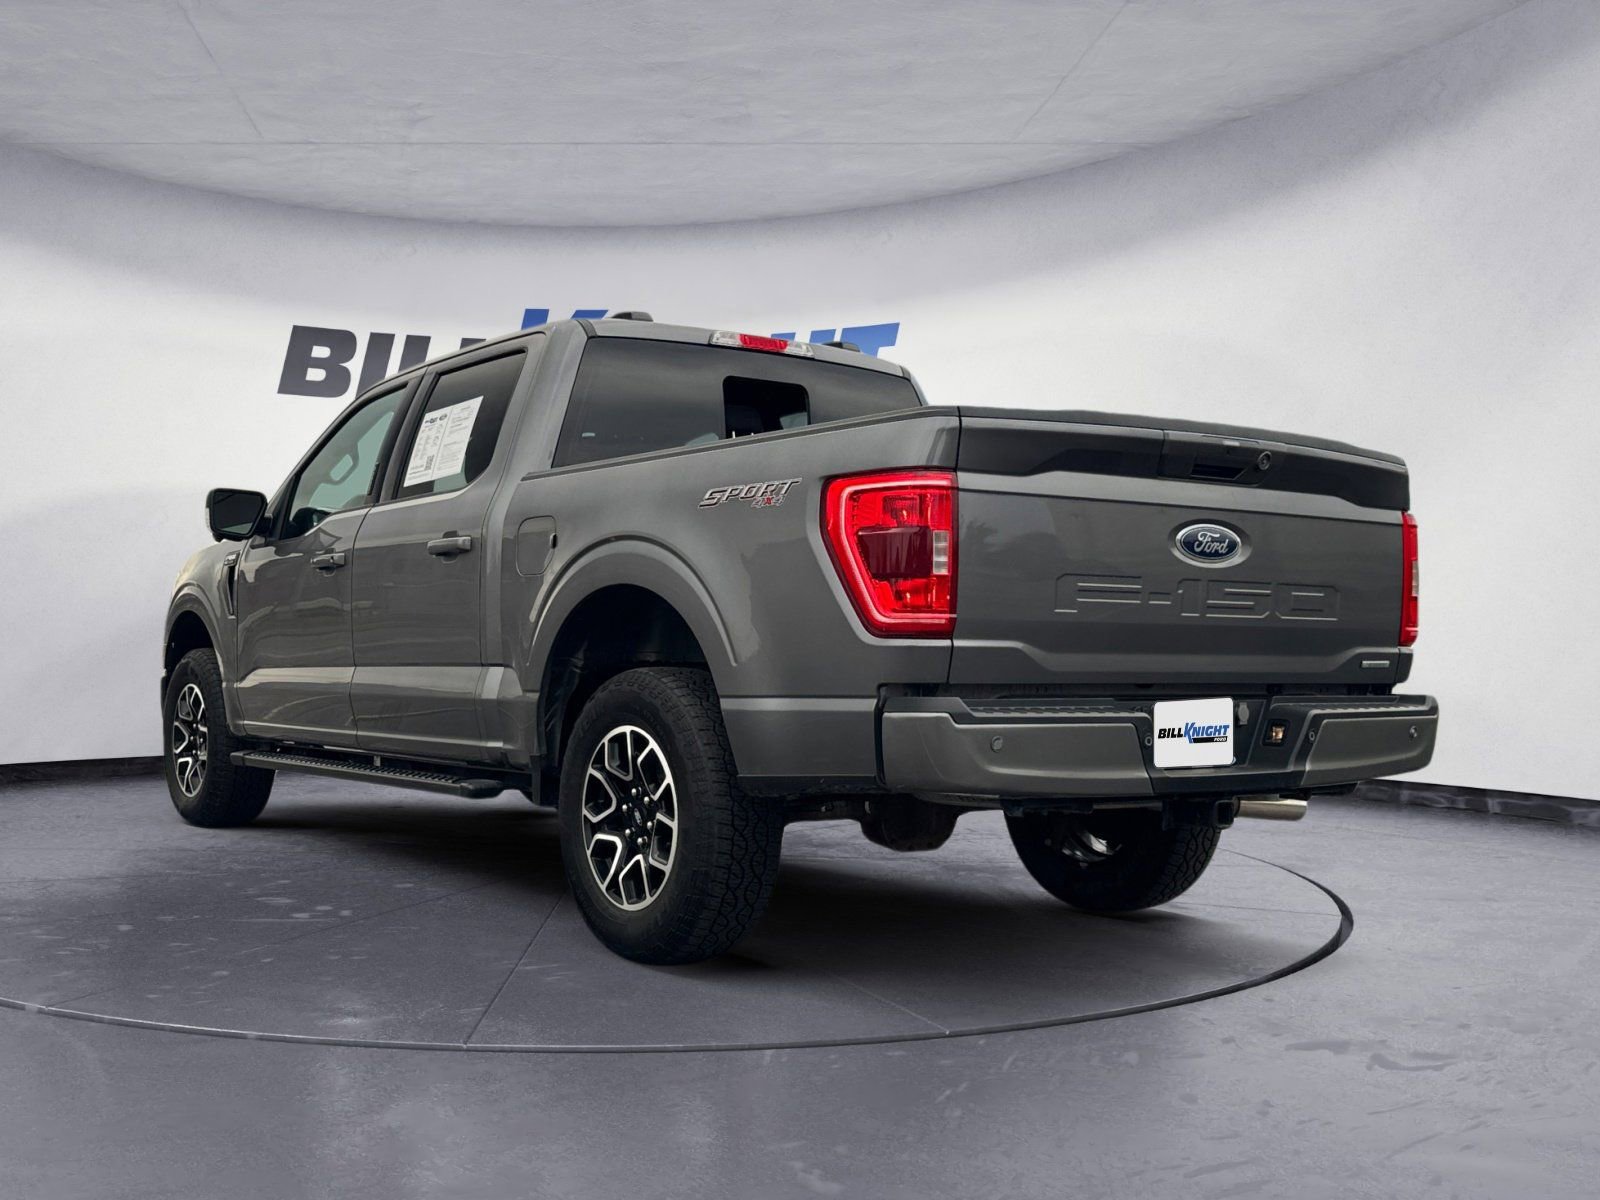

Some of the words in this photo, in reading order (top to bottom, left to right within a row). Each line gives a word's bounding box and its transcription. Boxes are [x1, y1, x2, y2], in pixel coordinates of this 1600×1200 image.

[698, 478, 802, 508] SPORT
[1193, 531, 1229, 554] Ford
[1054, 573, 1340, 621] F-150
